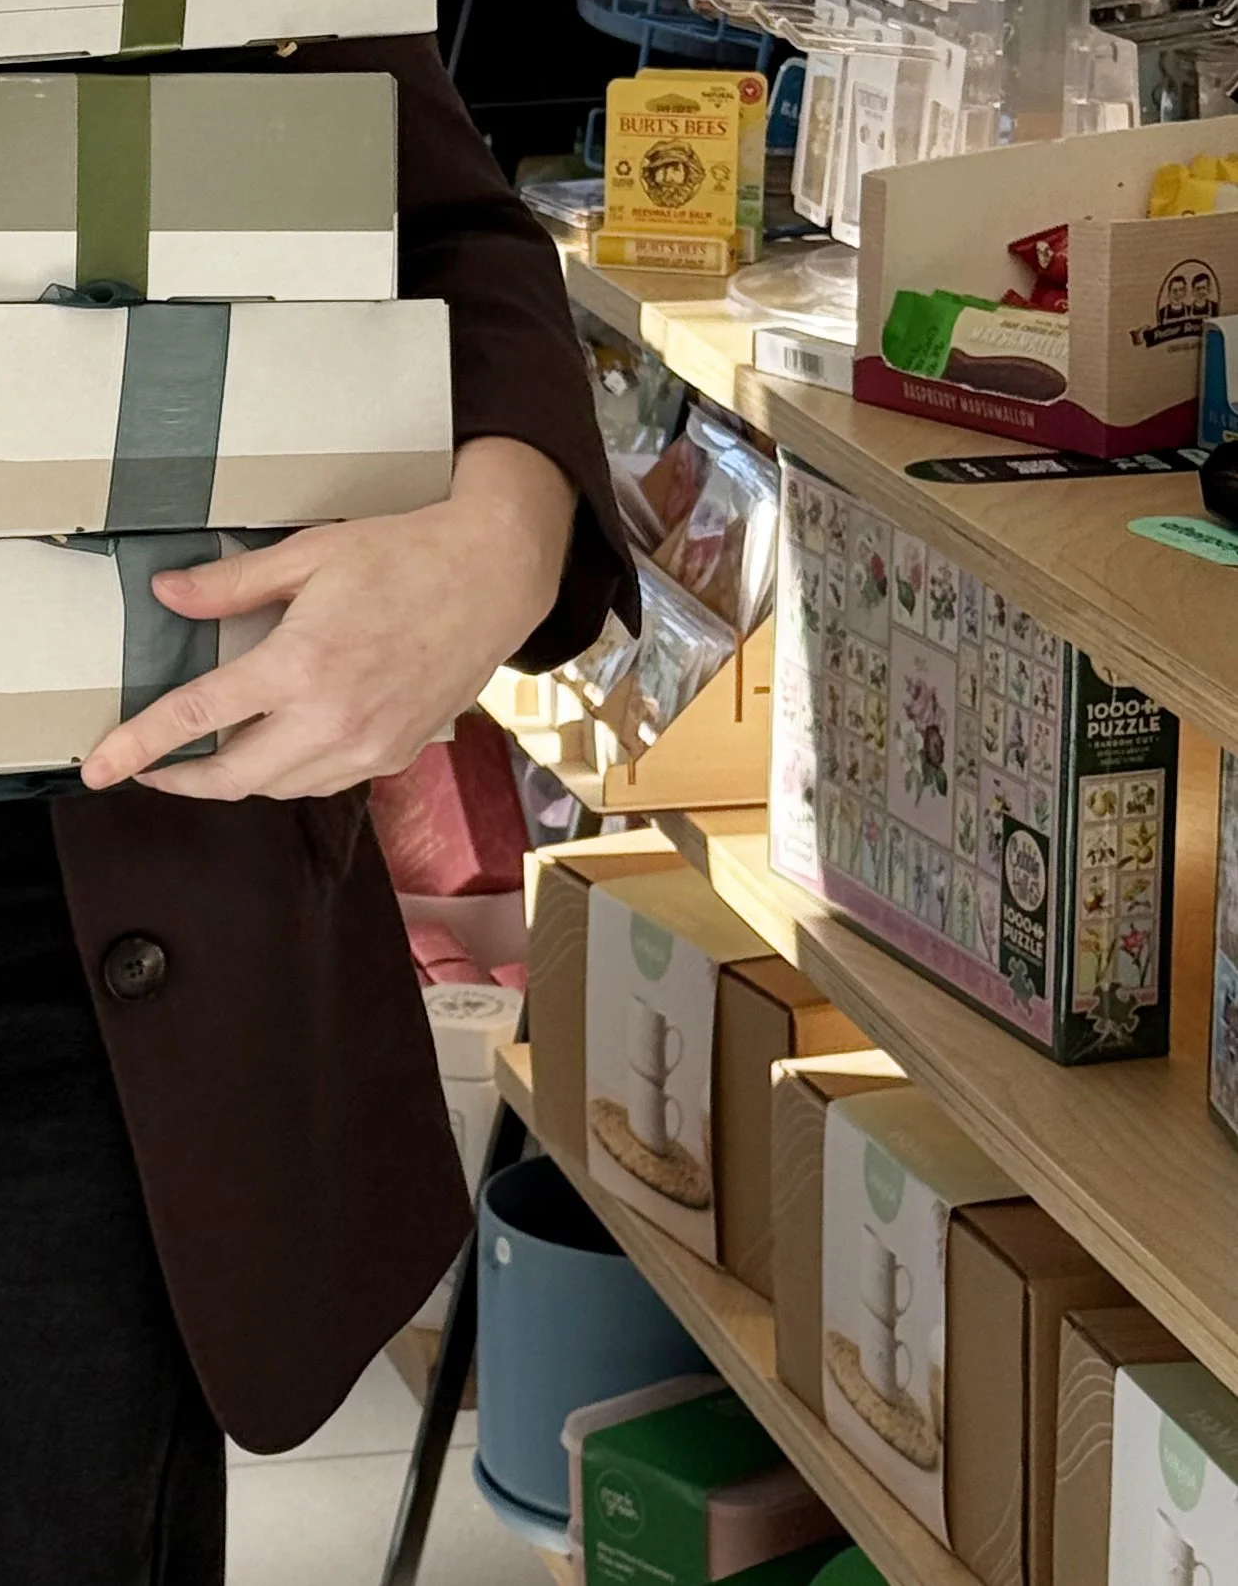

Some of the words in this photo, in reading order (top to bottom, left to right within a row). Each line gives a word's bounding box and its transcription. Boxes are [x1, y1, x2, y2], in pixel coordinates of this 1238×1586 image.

[619, 116, 679, 135] BURT'S
[684, 117, 728, 137] BEES
[632, 207, 671, 218] BEESWAX
[673, 209, 687, 219] LIP
[689, 210, 713, 220] BALM
[635, 239, 675, 255] BURT'S
[676, 241, 707, 256] BEES
[902, 381, 957, 410] RASPBERRY
[961, 395, 1036, 429] MARSHMALLOW
[1087, 715, 1162, 739] PUZZLE
[1003, 921, 1044, 960] PUZZLE
